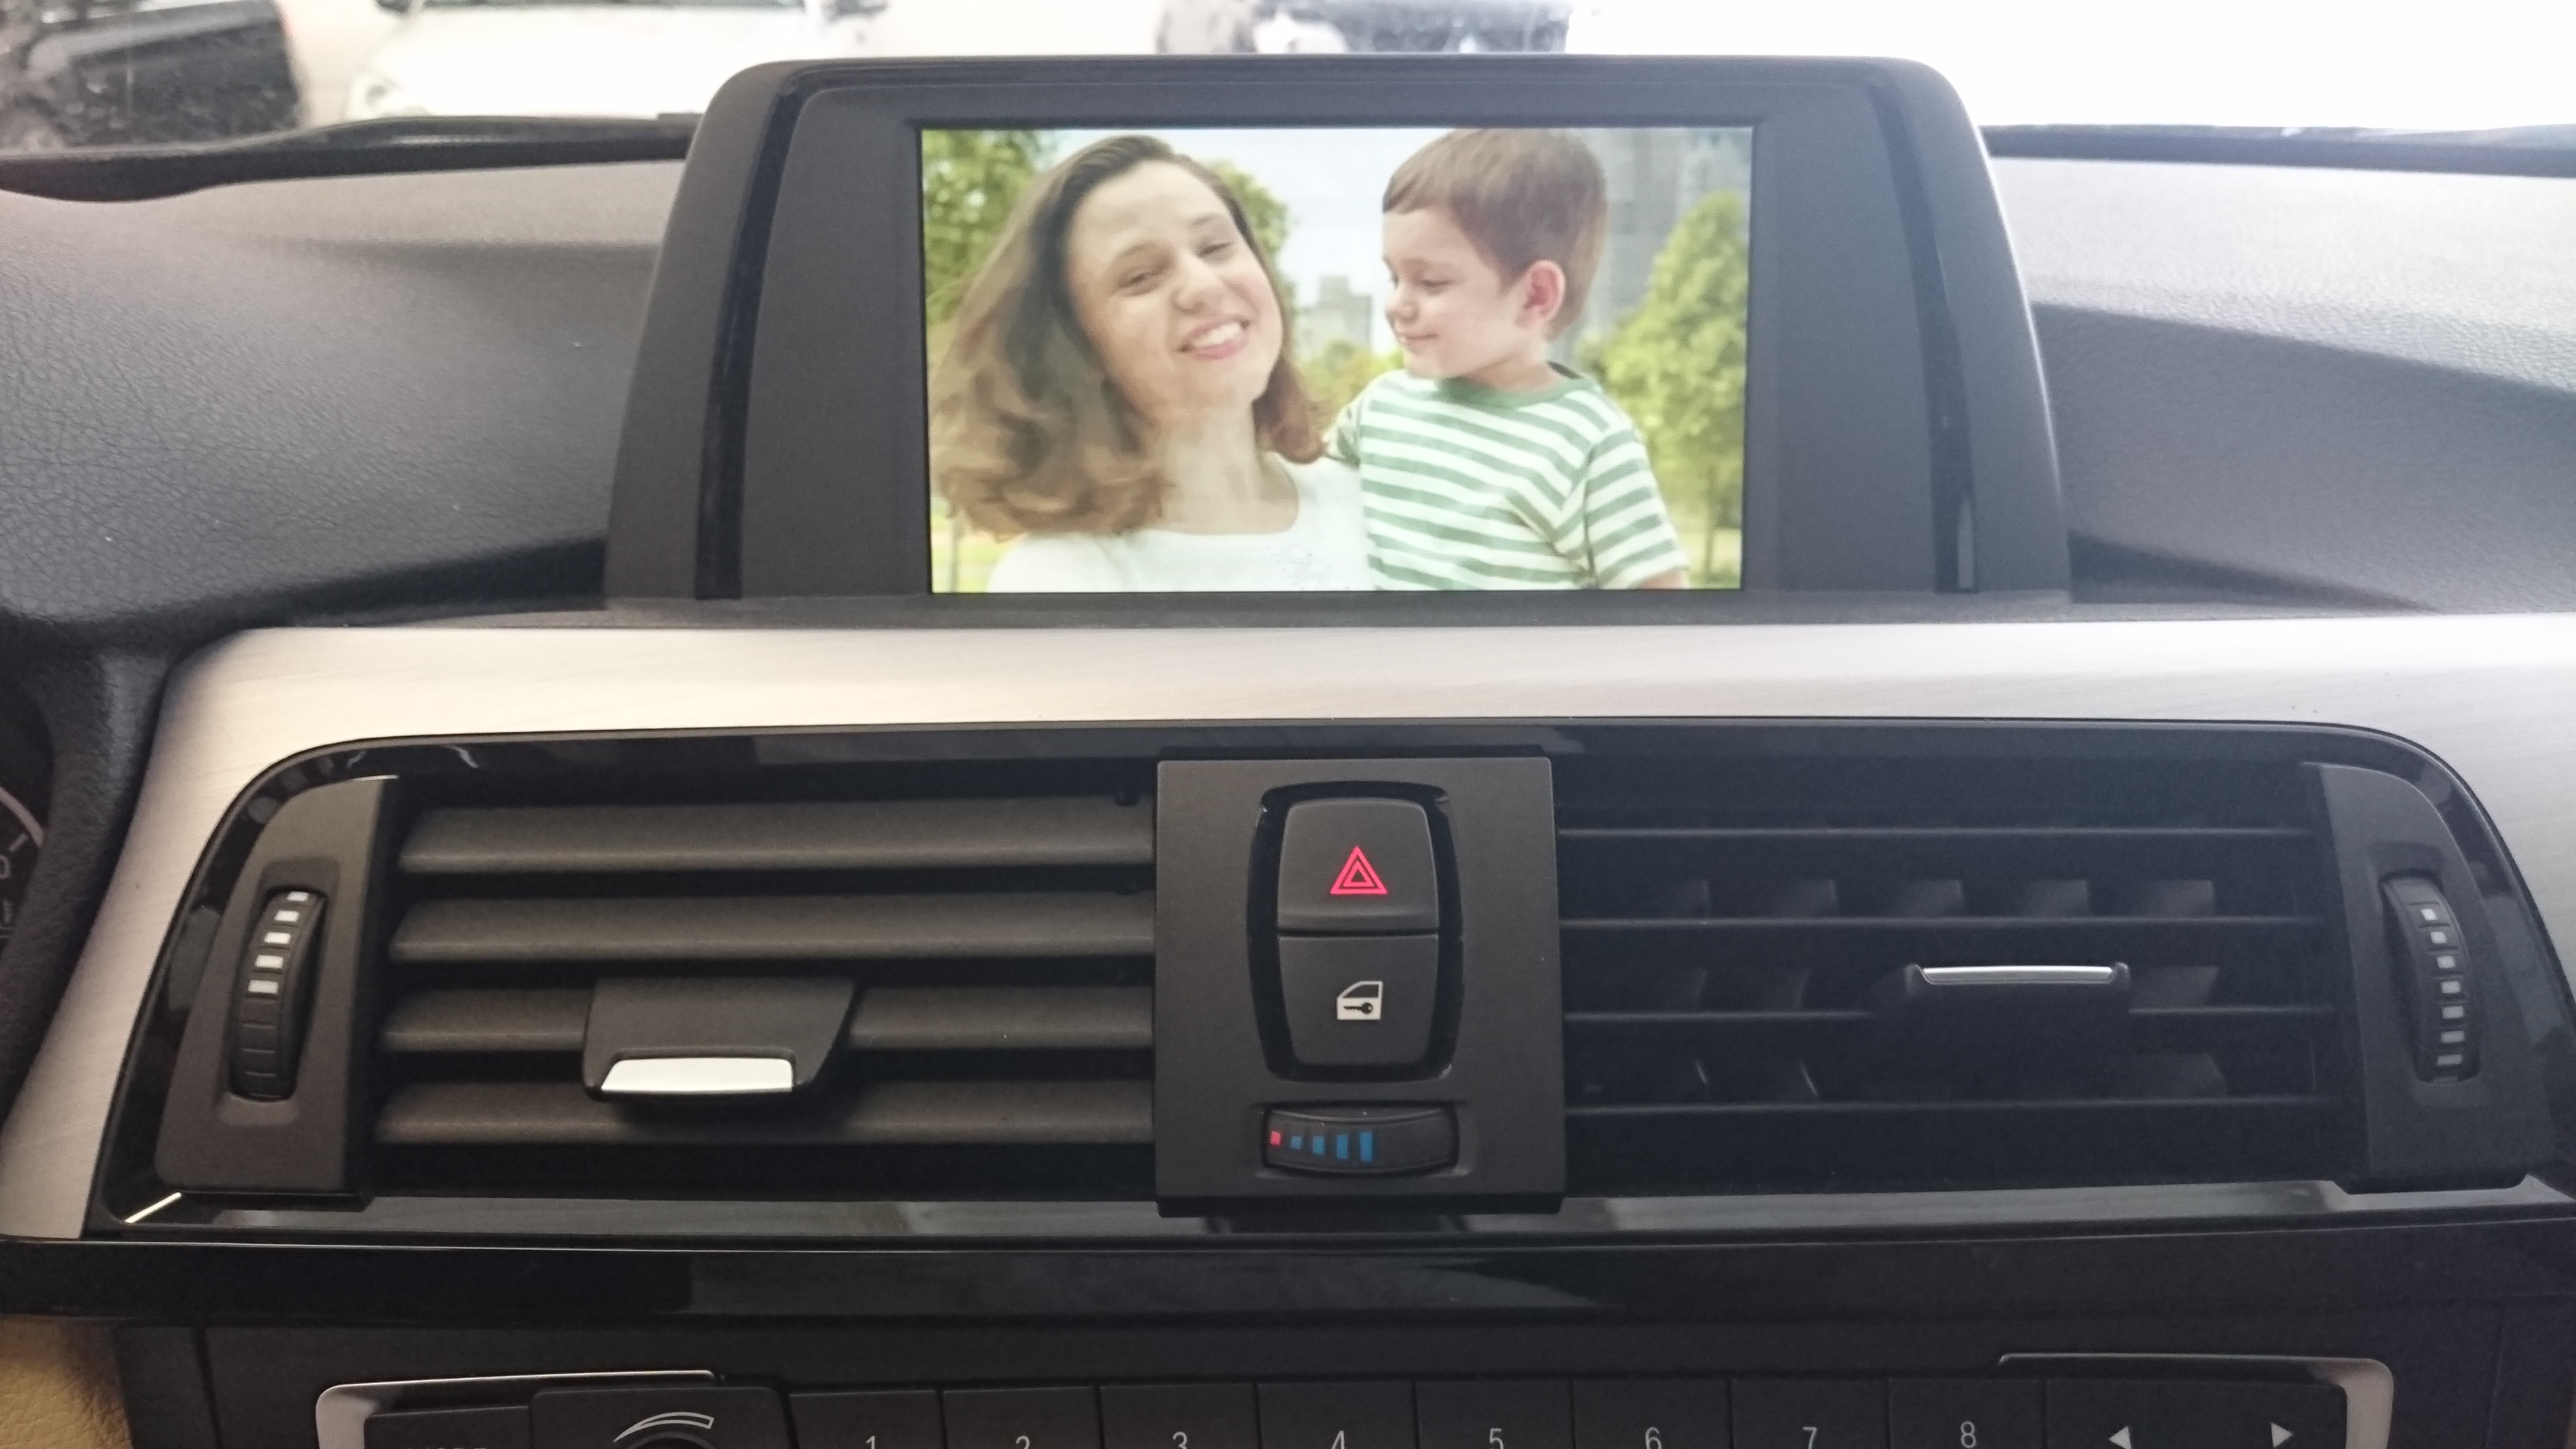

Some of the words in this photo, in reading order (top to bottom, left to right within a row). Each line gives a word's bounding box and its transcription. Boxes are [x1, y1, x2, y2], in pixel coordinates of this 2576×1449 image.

[1172, 1431, 1187, 1449] 3
[1330, 1430, 1345, 1449] 4
[1489, 1428, 1504, 1449] 5
[1644, 1427, 1662, 1449] 6
[1802, 1426, 1817, 1449] 7
[1960, 1421, 1976, 1448] 8
